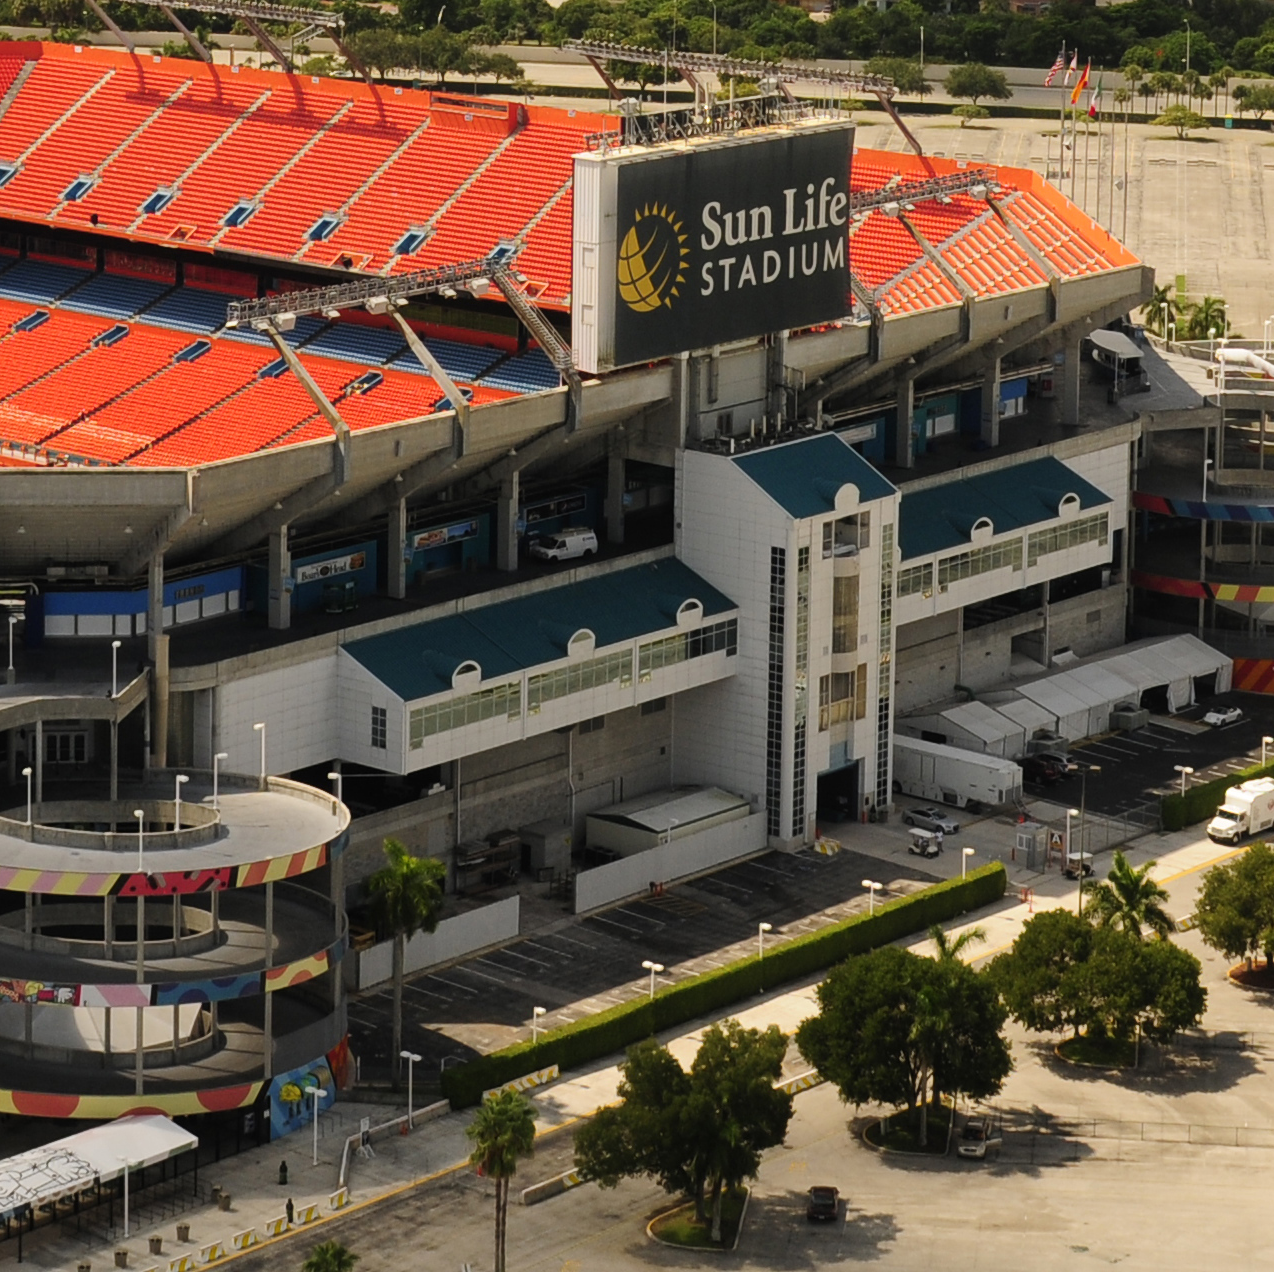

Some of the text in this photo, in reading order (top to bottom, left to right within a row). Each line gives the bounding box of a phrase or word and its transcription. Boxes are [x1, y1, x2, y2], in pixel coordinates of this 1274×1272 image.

[701, 177, 847, 251] Sun Life
[700, 236, 845, 296] STADIUM
[1051, 833, 1061, 845] A
